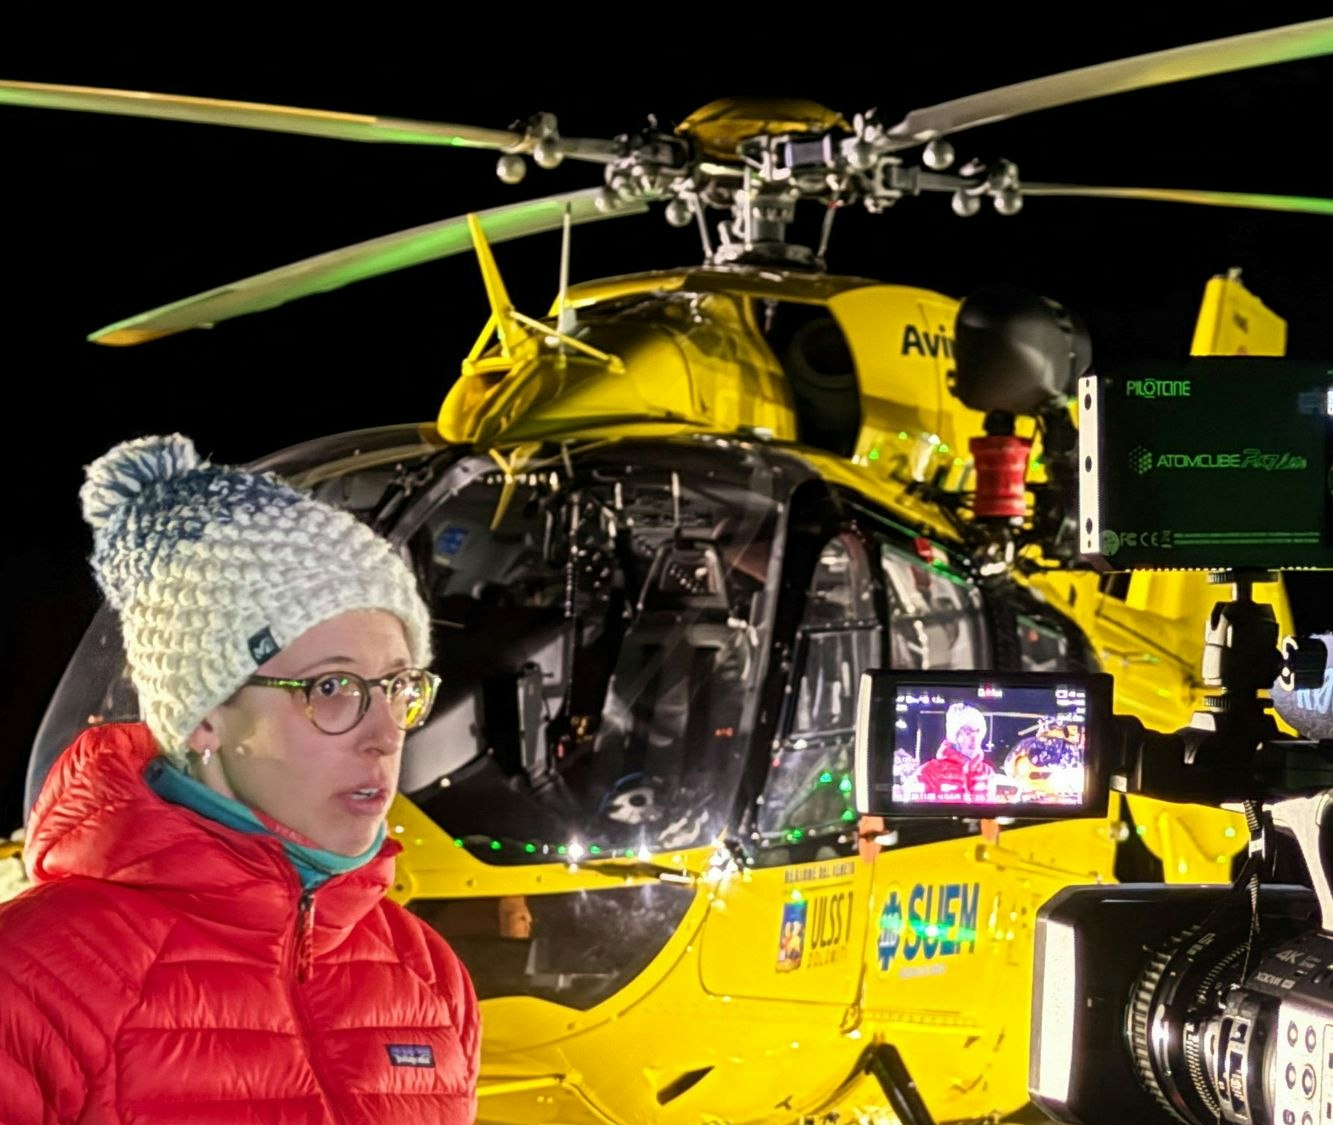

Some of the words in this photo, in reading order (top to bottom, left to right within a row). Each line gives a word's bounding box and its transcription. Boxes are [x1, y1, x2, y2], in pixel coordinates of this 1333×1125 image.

[1157, 453, 1241, 468] ATOMCUBE
[811, 893, 845, 950] ULSS
[903, 882, 980, 961] SUEM
[1275, 949, 1305, 964] 4K
